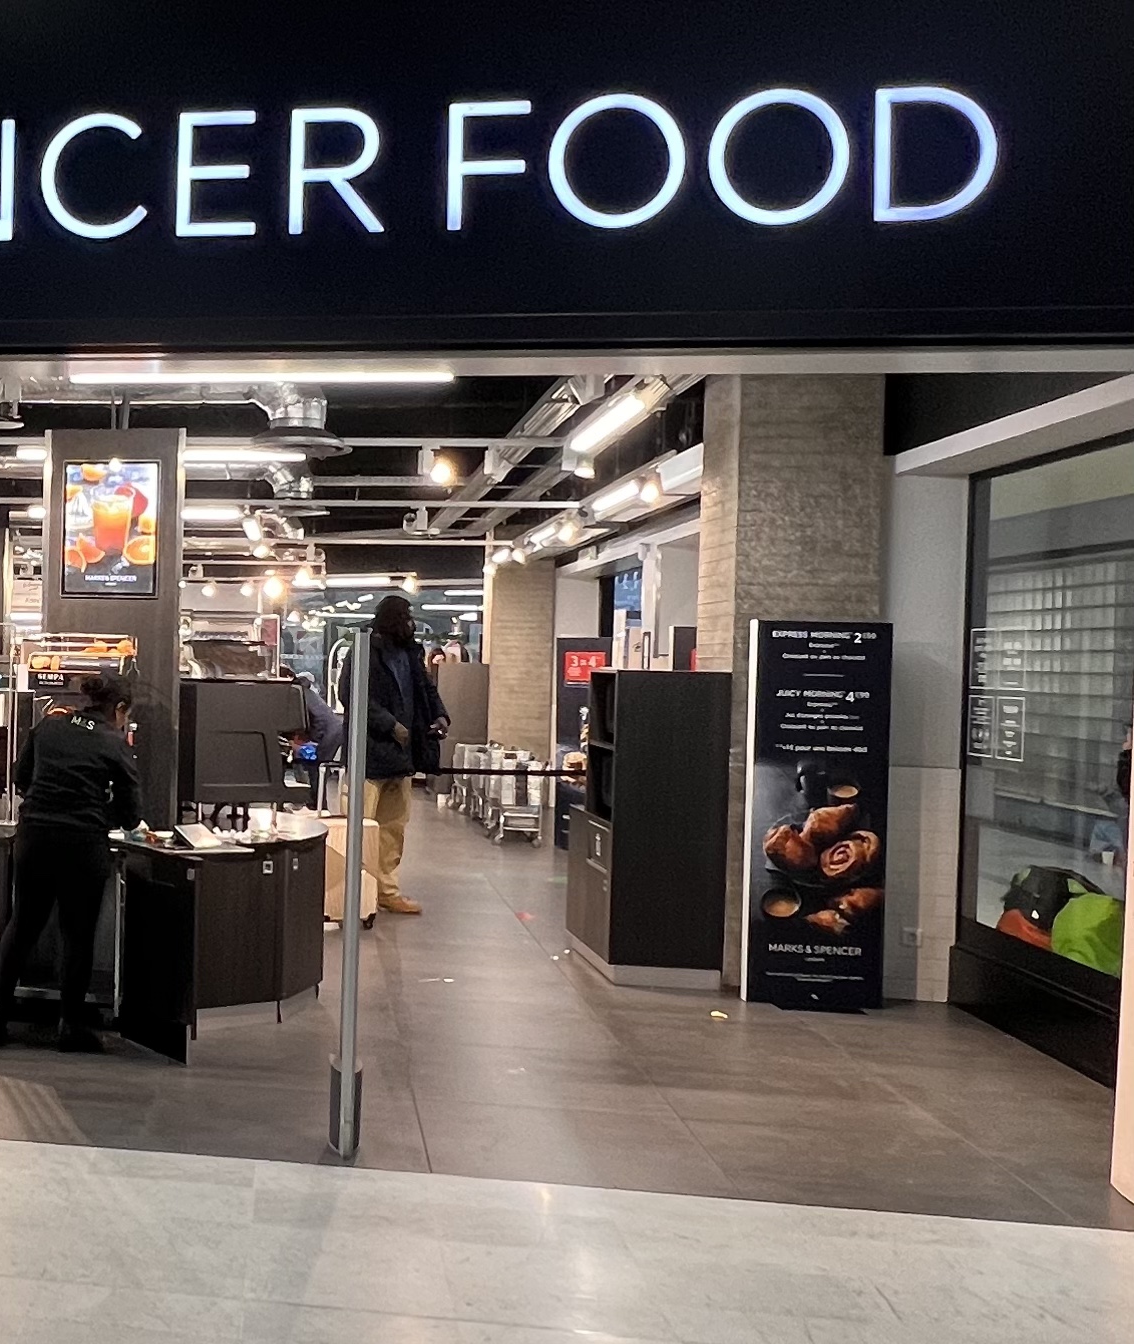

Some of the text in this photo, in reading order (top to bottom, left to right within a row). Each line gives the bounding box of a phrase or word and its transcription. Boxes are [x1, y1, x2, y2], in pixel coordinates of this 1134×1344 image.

[446, 85, 999, 231] FOOD
[776, 689, 801, 697] JUICY
[768, 943, 862, 957] MARKS & SPENCER
